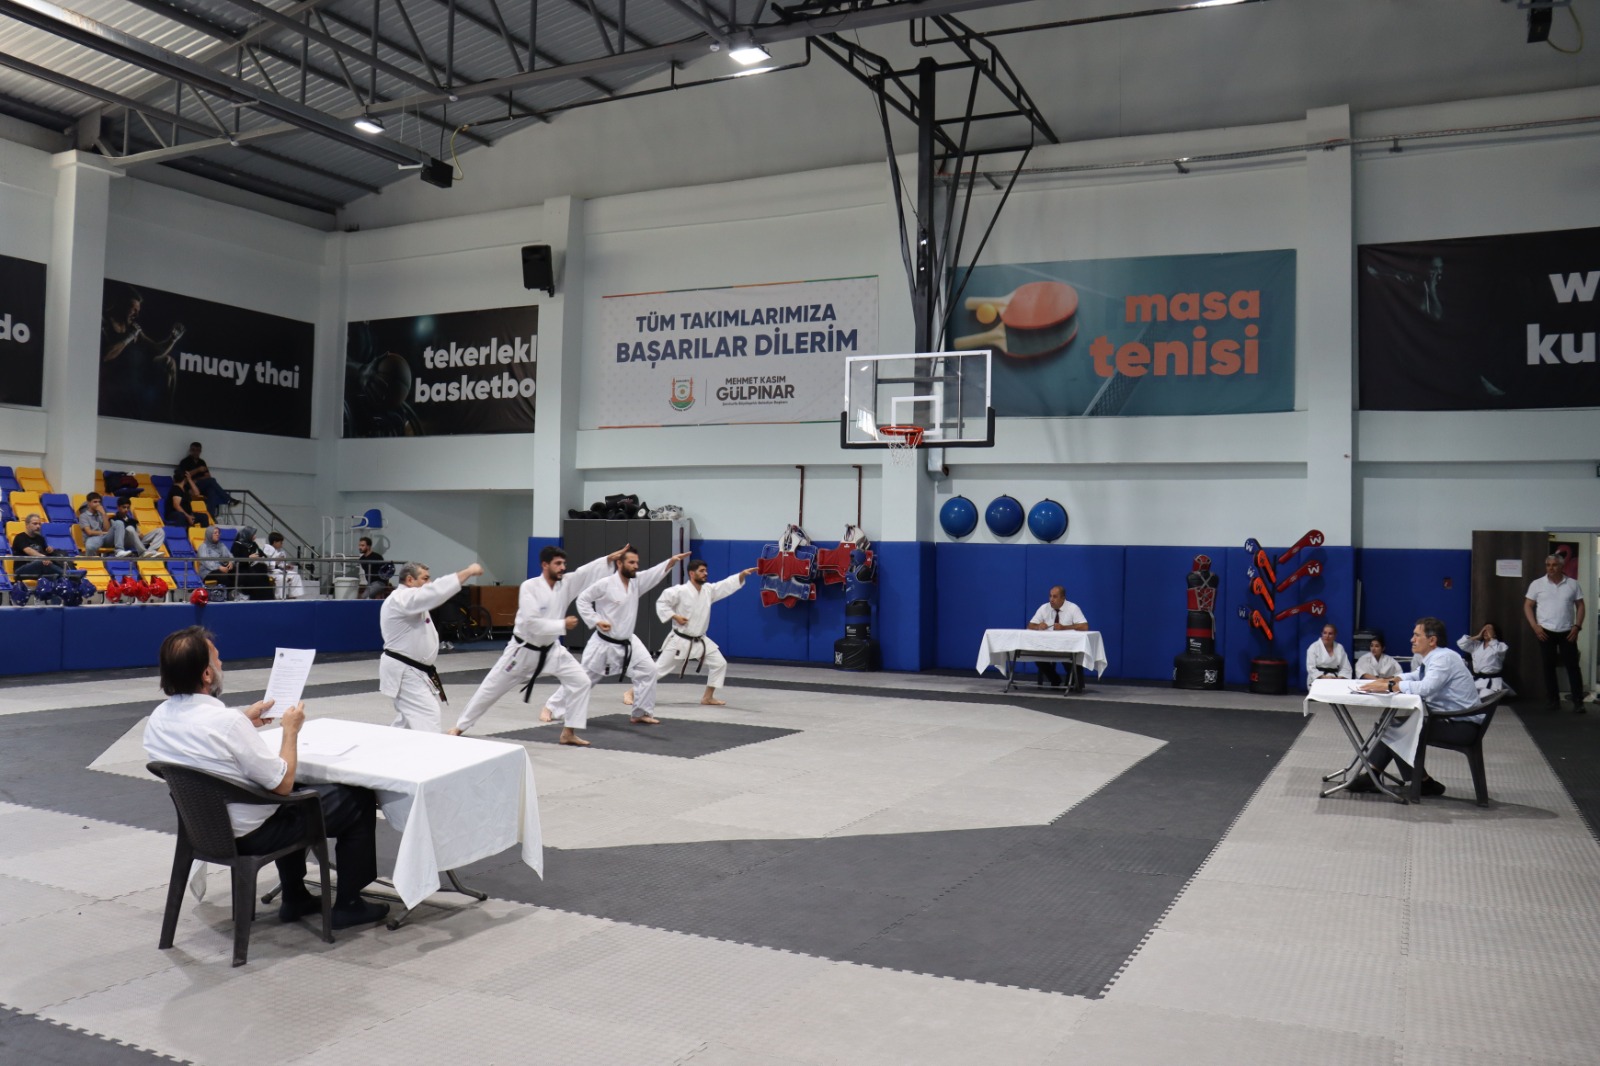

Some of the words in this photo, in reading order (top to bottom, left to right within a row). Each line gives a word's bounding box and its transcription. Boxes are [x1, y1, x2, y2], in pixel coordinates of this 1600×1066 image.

[636, 311, 675, 333] TÜM
[680, 303, 836, 330] TAKIMLARIMIZA
[1125, 290, 1260, 323] masa
[616, 335, 747, 369] BAŞARILAR
[755, 324, 858, 356] DİLERİM
[1089, 324, 1259, 377] tenisi
[179, 352, 249, 385] muay
[255, 360, 299, 389] thai
[725, 376, 759, 385] MEHMET
[760, 375, 786, 384] KASIM
[415, 372, 535, 403] basketbo
[716, 384, 795, 401] GÜLPINAR
